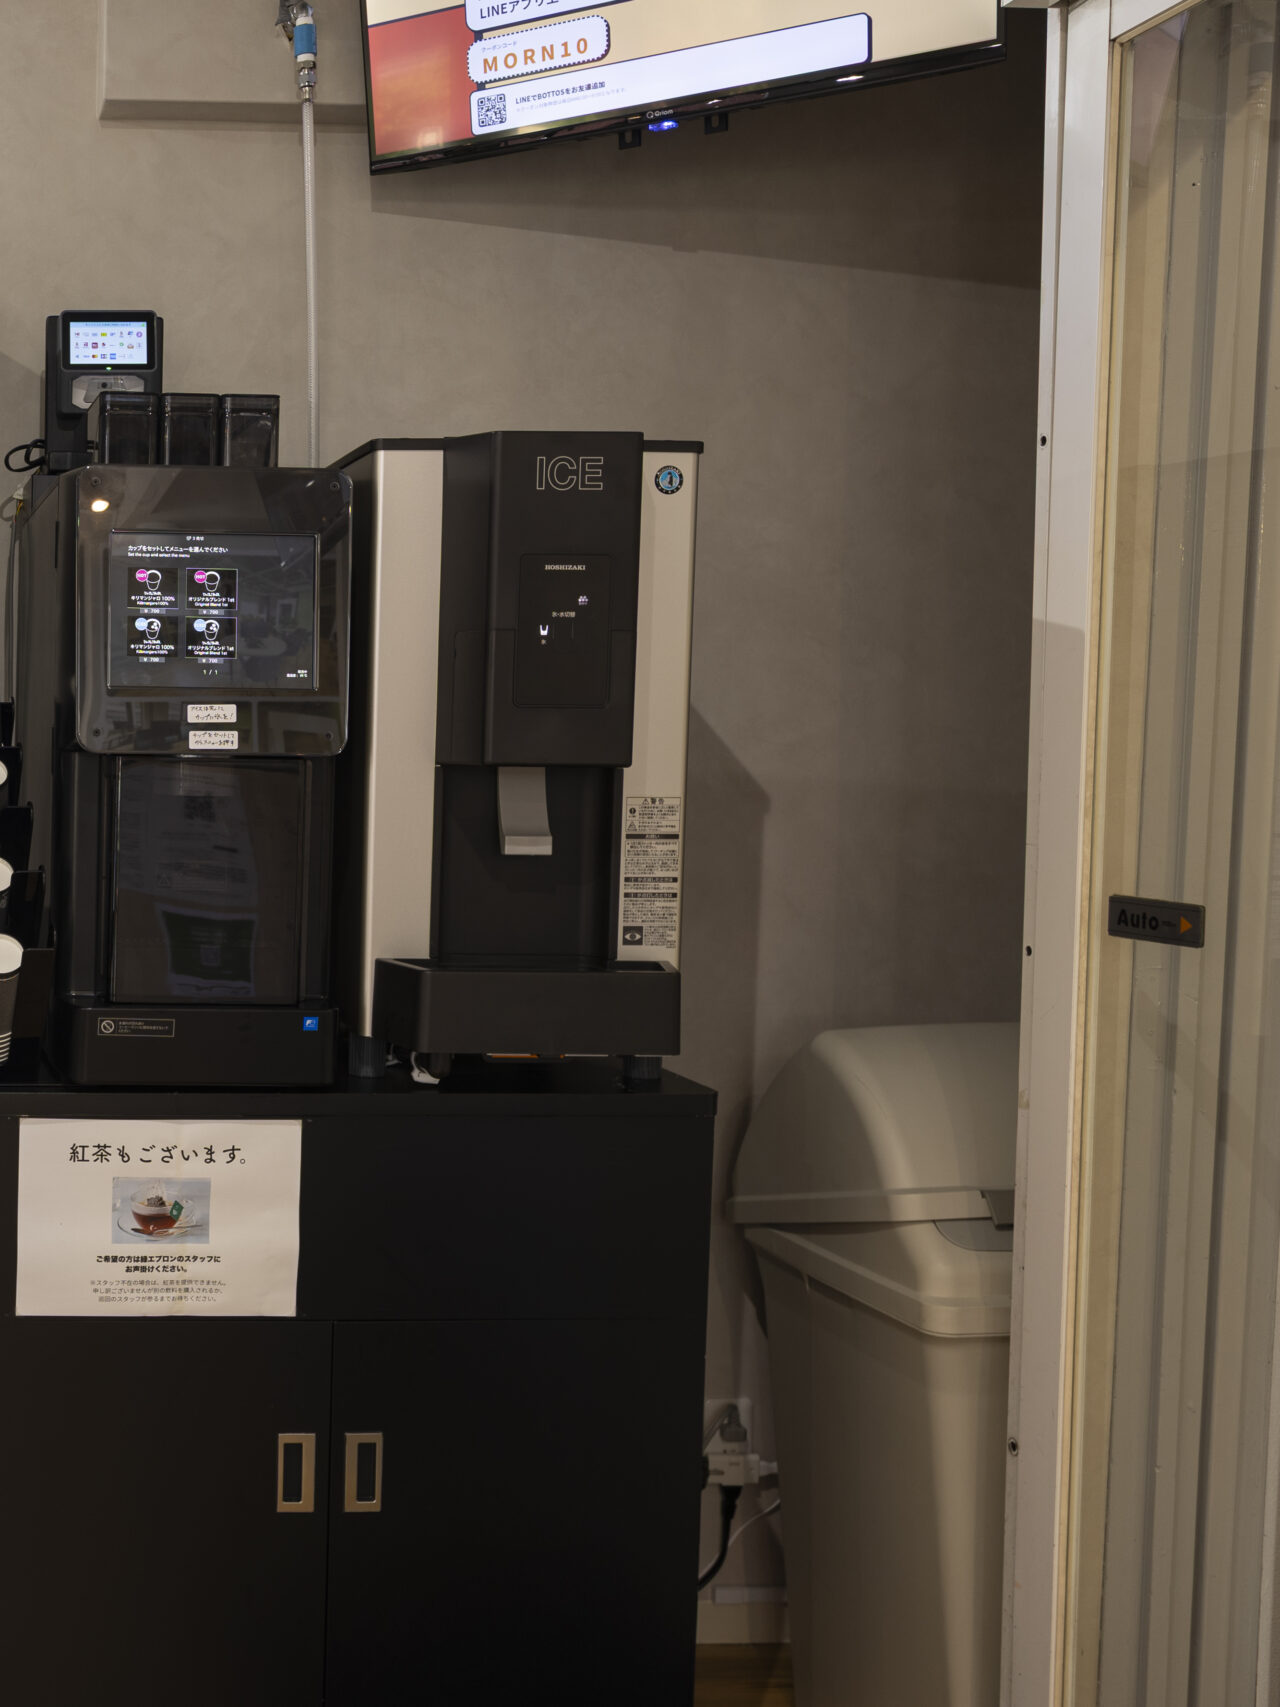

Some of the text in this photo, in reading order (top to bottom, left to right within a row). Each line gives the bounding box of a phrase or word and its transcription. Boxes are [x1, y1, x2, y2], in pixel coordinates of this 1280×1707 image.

[483, 38, 588, 74] MORN10
[536, 455, 604, 491] ICE
[1117, 908, 1160, 931] Auto
[69, 1143, 246, 1164] 紅茶もございます。
[125, 1265, 188, 1273] お声掛けください。
